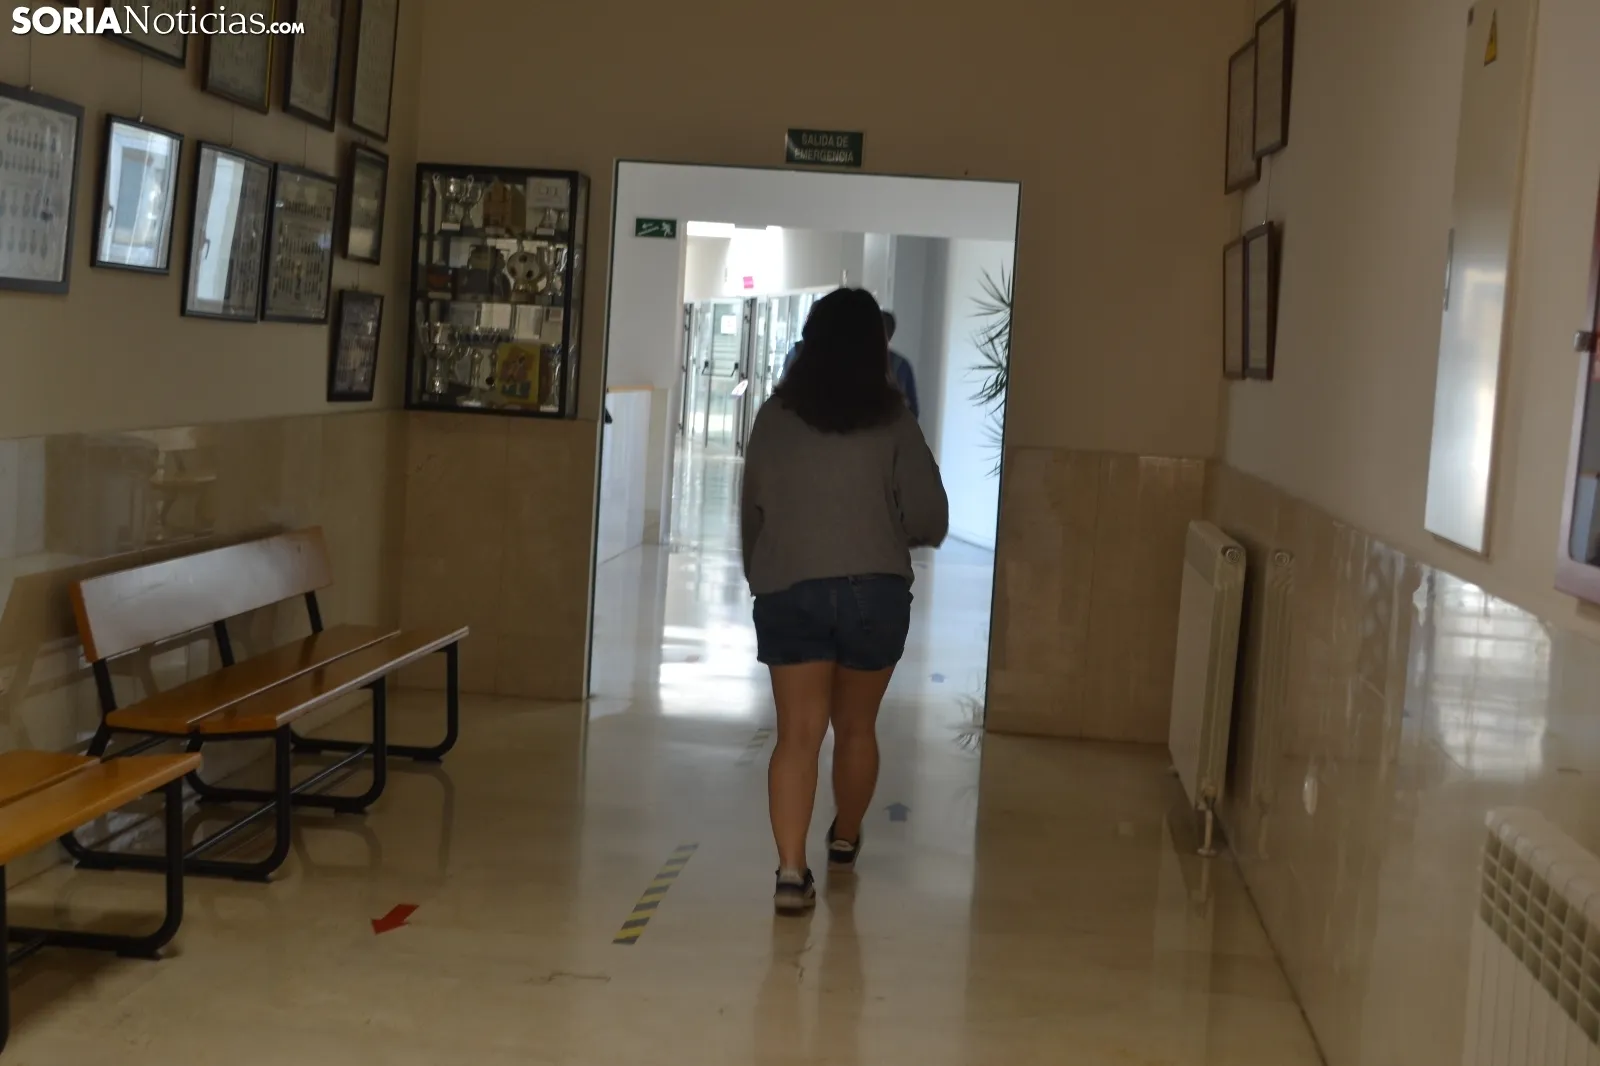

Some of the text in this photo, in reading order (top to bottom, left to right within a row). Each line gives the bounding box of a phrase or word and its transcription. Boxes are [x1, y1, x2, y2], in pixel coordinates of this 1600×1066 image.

[801, 132, 849, 148] SALIDA DE
[794, 147, 854, 163] EMERGENCIA
